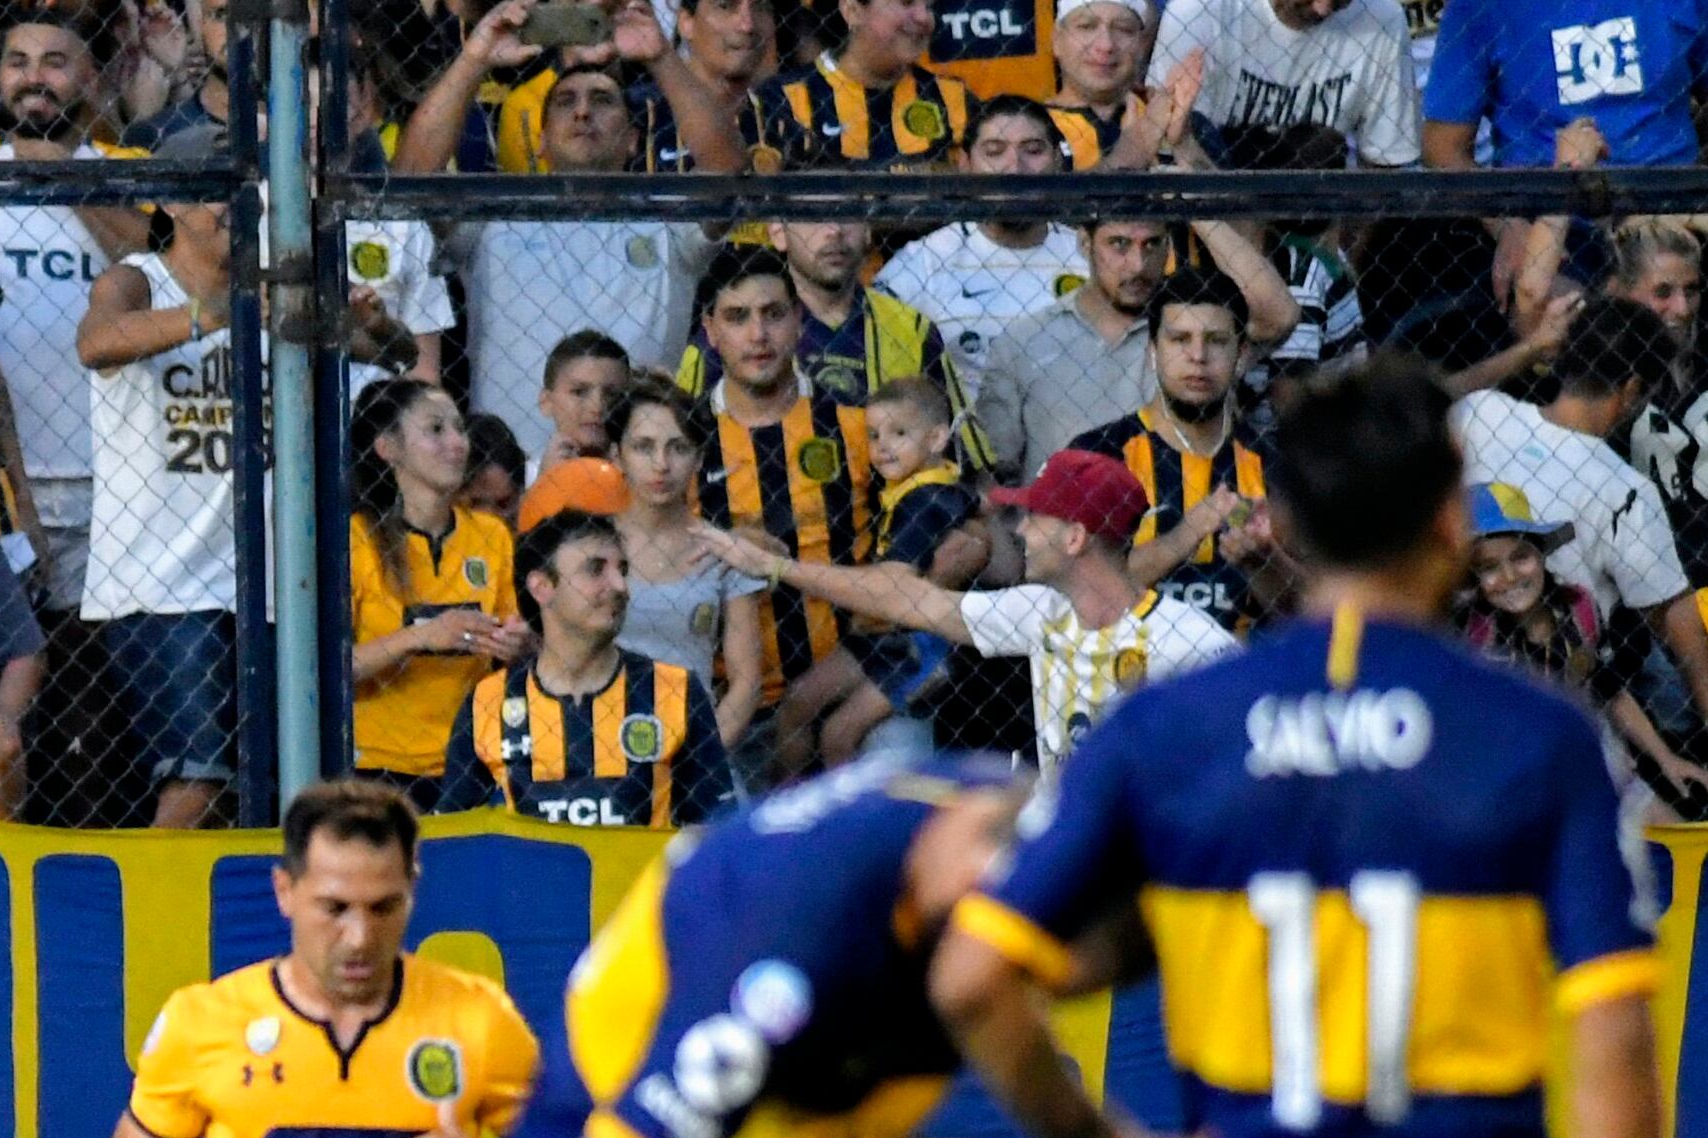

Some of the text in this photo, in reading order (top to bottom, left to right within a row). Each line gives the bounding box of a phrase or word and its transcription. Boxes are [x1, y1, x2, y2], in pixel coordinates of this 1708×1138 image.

[941, 9, 1023, 40] TCL
[1226, 68, 1352, 128] EVERLAST
[4, 247, 95, 282] TCL
[1155, 582, 1234, 611] TCL
[538, 797, 625, 827] TCL
[1246, 870, 1423, 1131] 11
